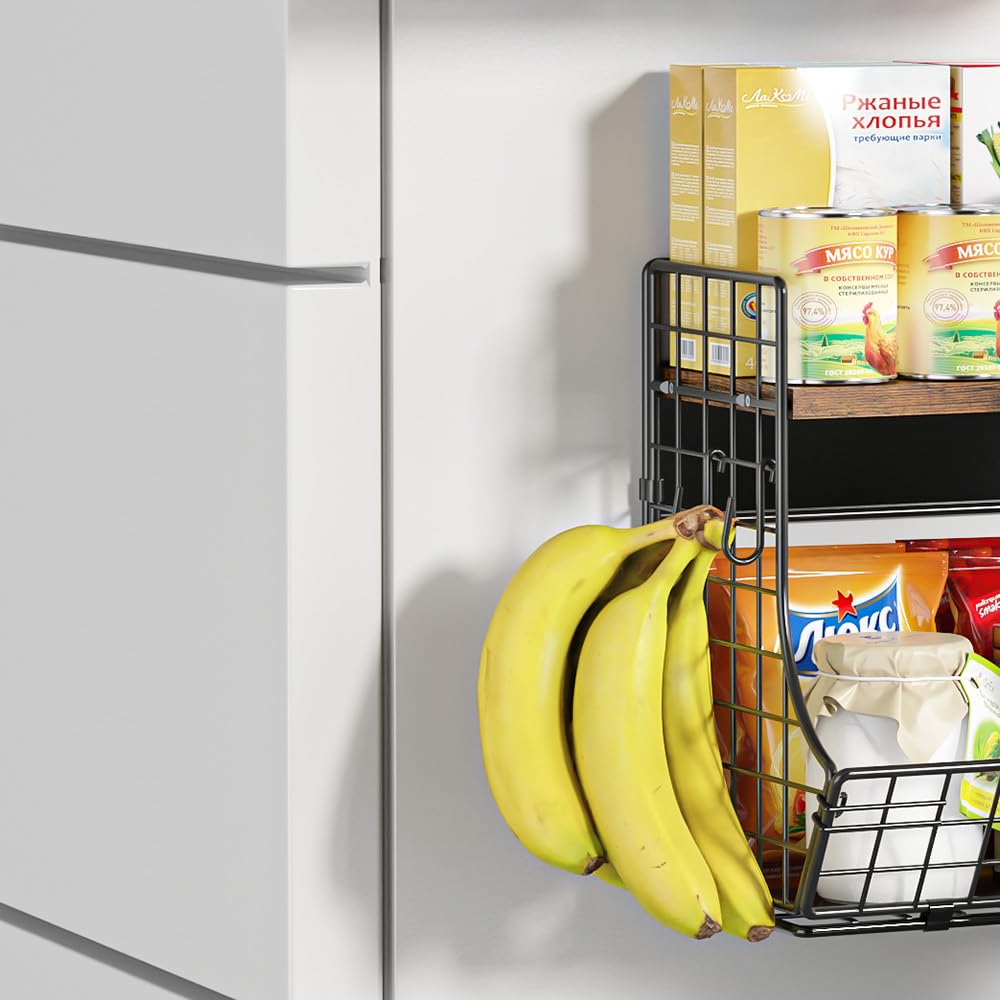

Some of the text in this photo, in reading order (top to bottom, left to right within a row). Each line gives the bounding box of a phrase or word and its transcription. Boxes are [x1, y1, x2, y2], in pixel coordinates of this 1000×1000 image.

[842, 93, 941, 111] Ржаные
[851, 114, 941, 129] хлопья
[853, 133, 942, 144] требующие варки
[825, 245, 873, 263] МЯСО
